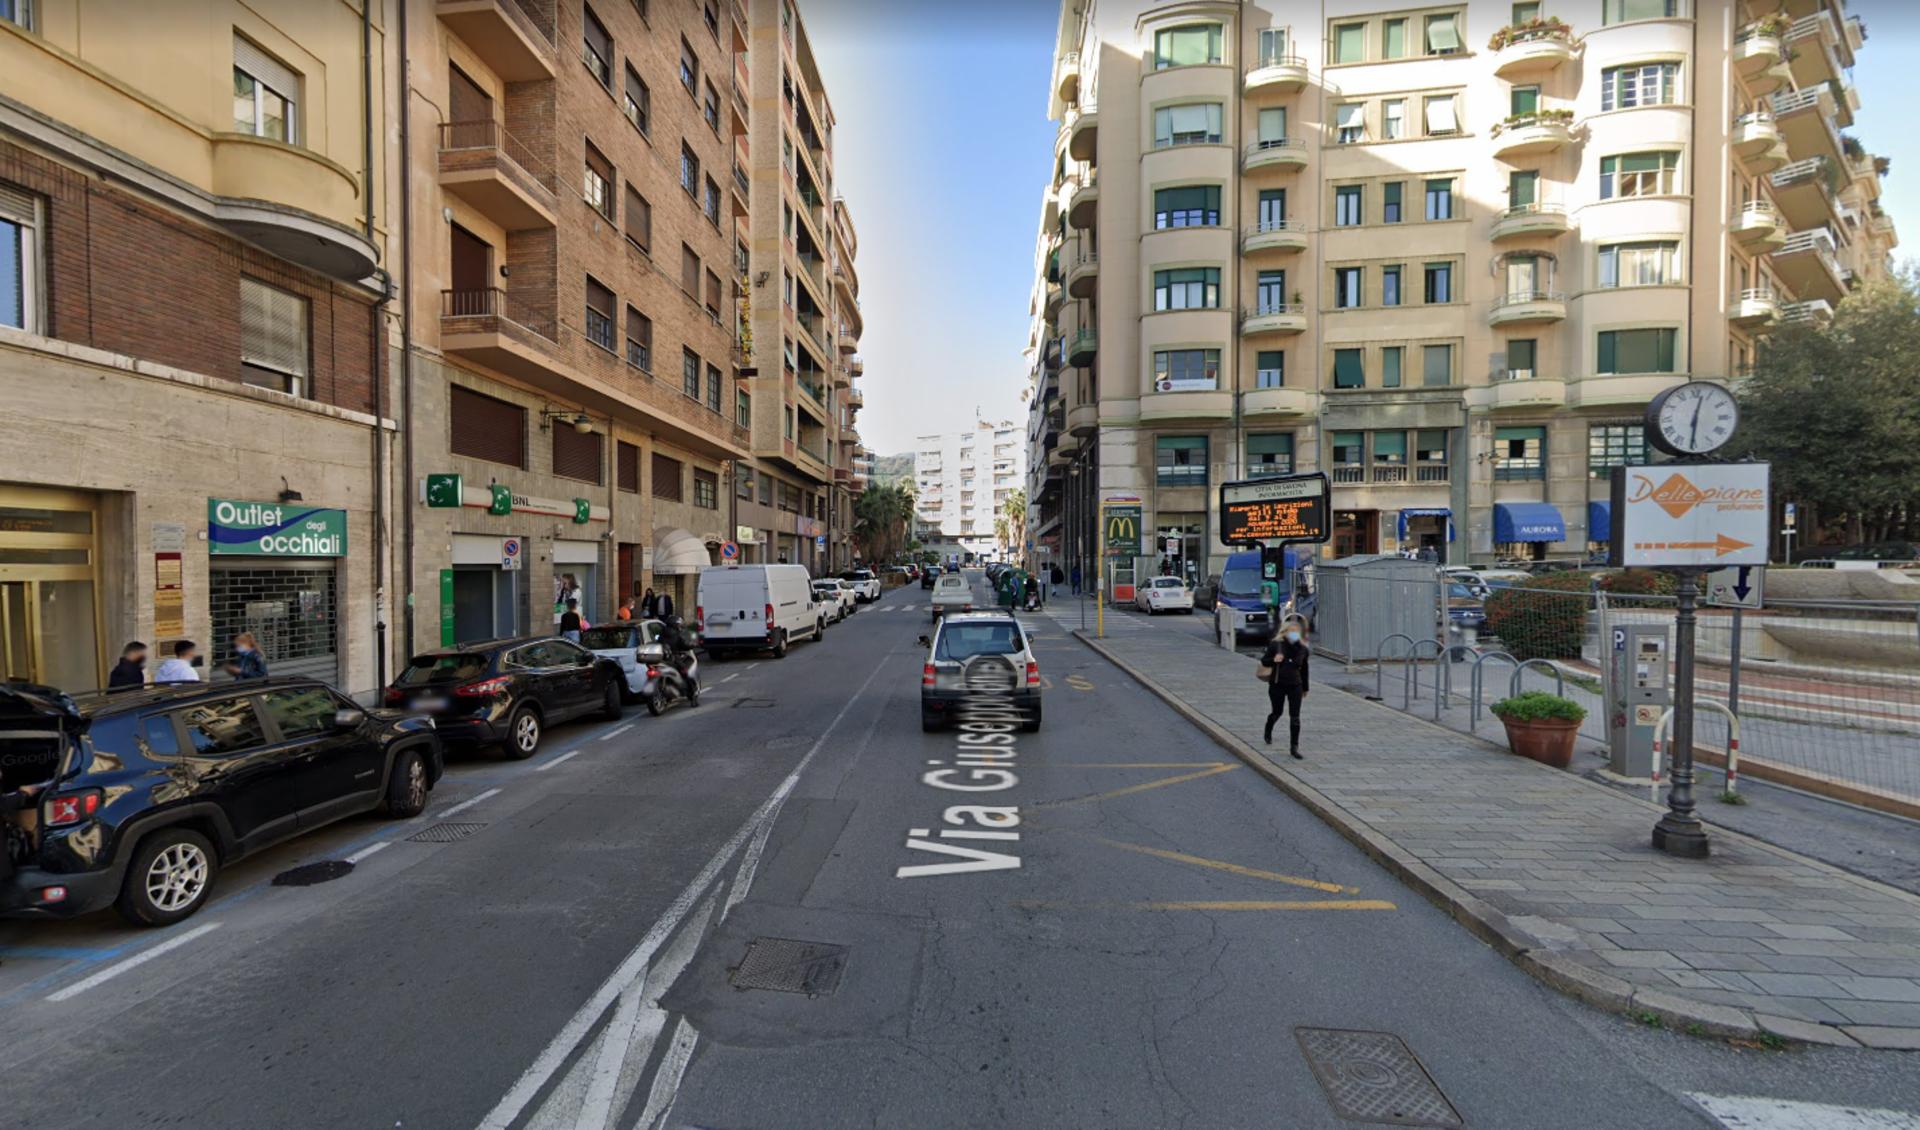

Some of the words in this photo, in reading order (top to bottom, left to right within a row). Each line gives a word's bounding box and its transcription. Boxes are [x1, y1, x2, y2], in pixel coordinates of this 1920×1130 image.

[512, 496, 531, 507] BNL
[216, 502, 282, 526] Outlet
[306, 521, 326, 532] degli
[1520, 526, 1558, 534] AURORA
[260, 533, 340, 554] occhiali
[1614, 631, 1625, 648] P
